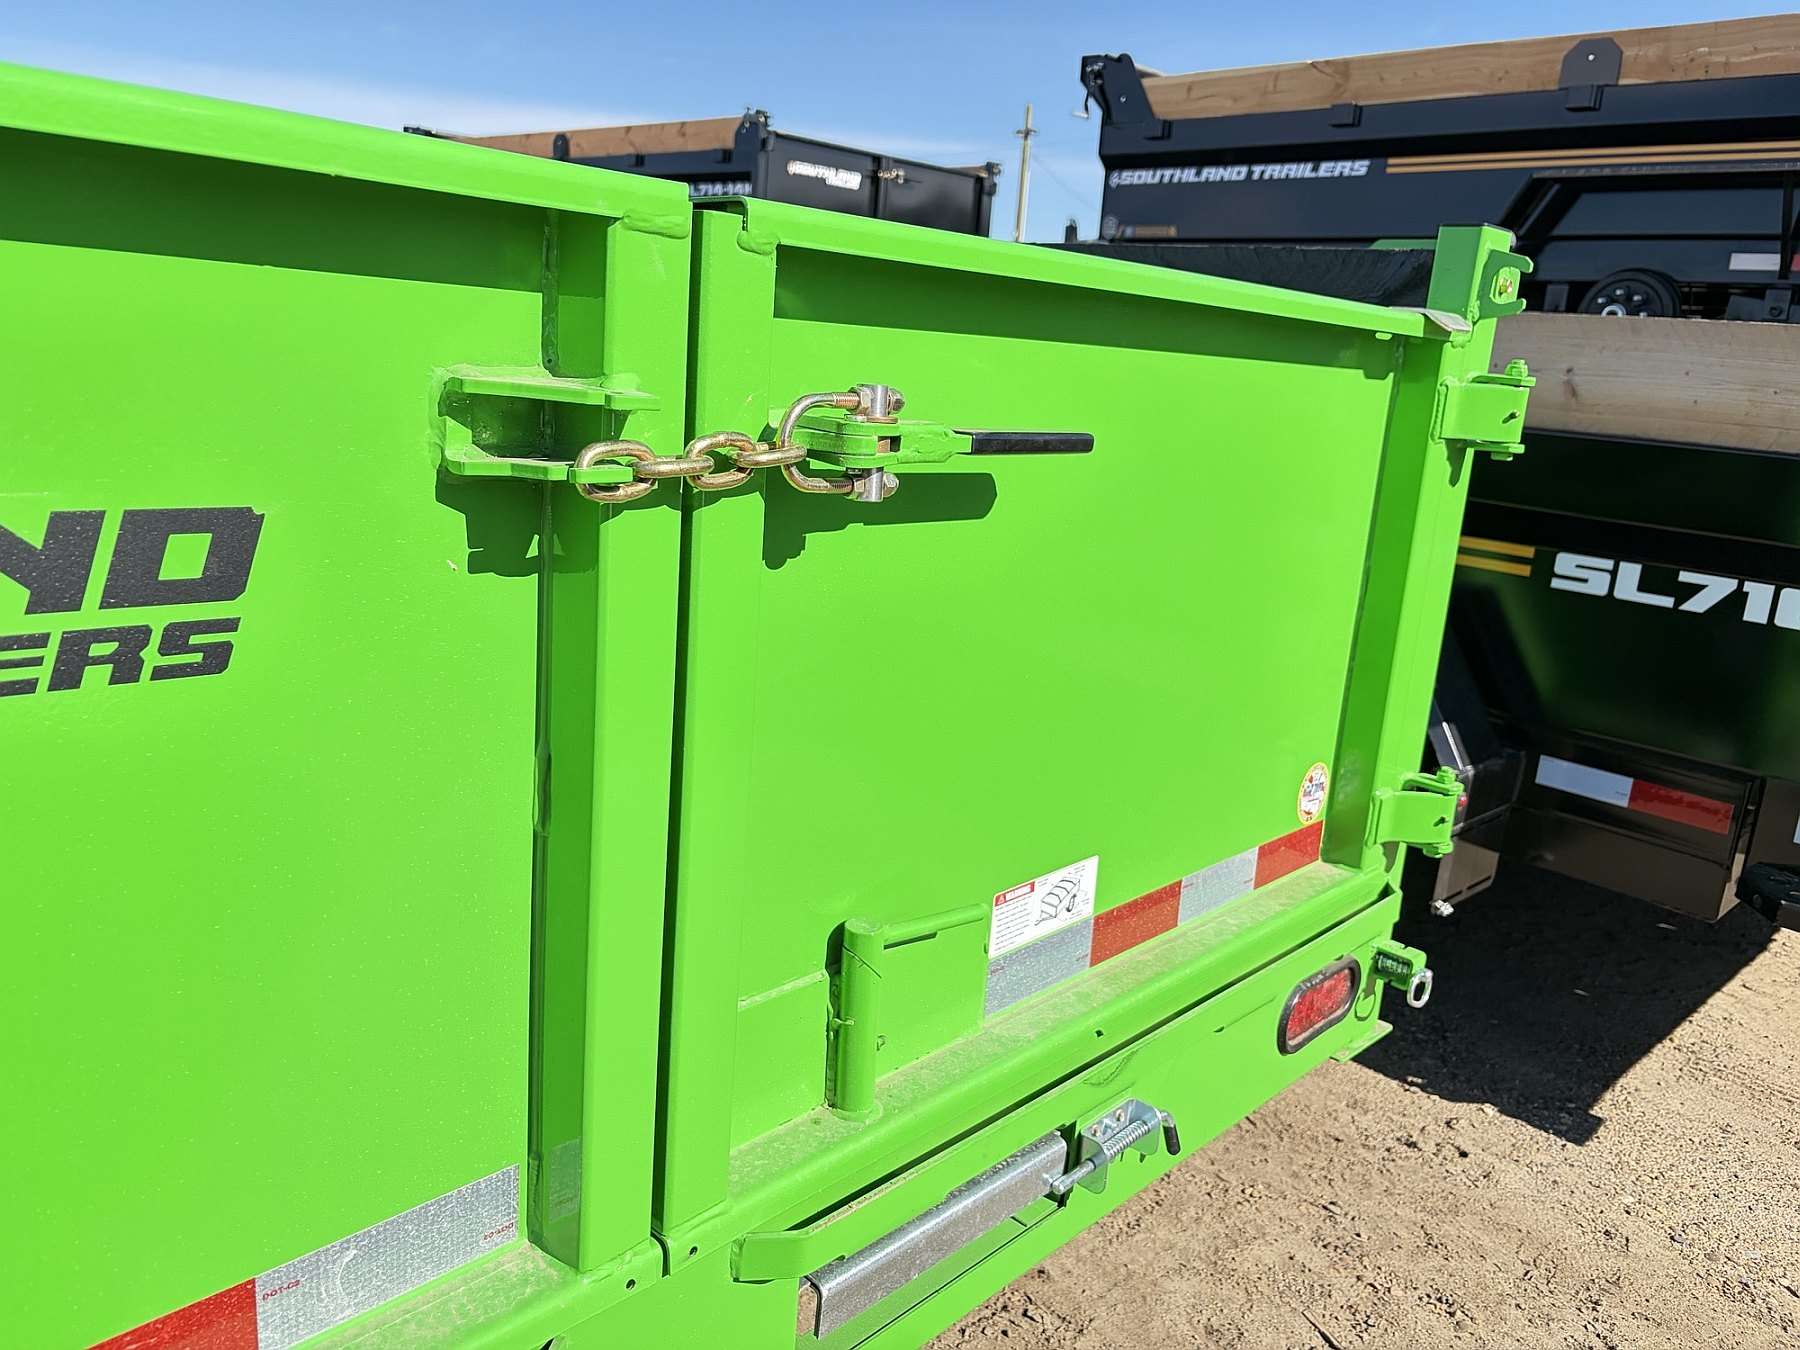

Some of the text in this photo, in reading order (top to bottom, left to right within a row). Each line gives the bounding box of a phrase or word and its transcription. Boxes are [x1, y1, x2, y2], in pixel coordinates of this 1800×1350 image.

[1119, 160, 1370, 185] SOUTHLAND TRAILERS
[262, 1279, 301, 1302] DOT-C2
